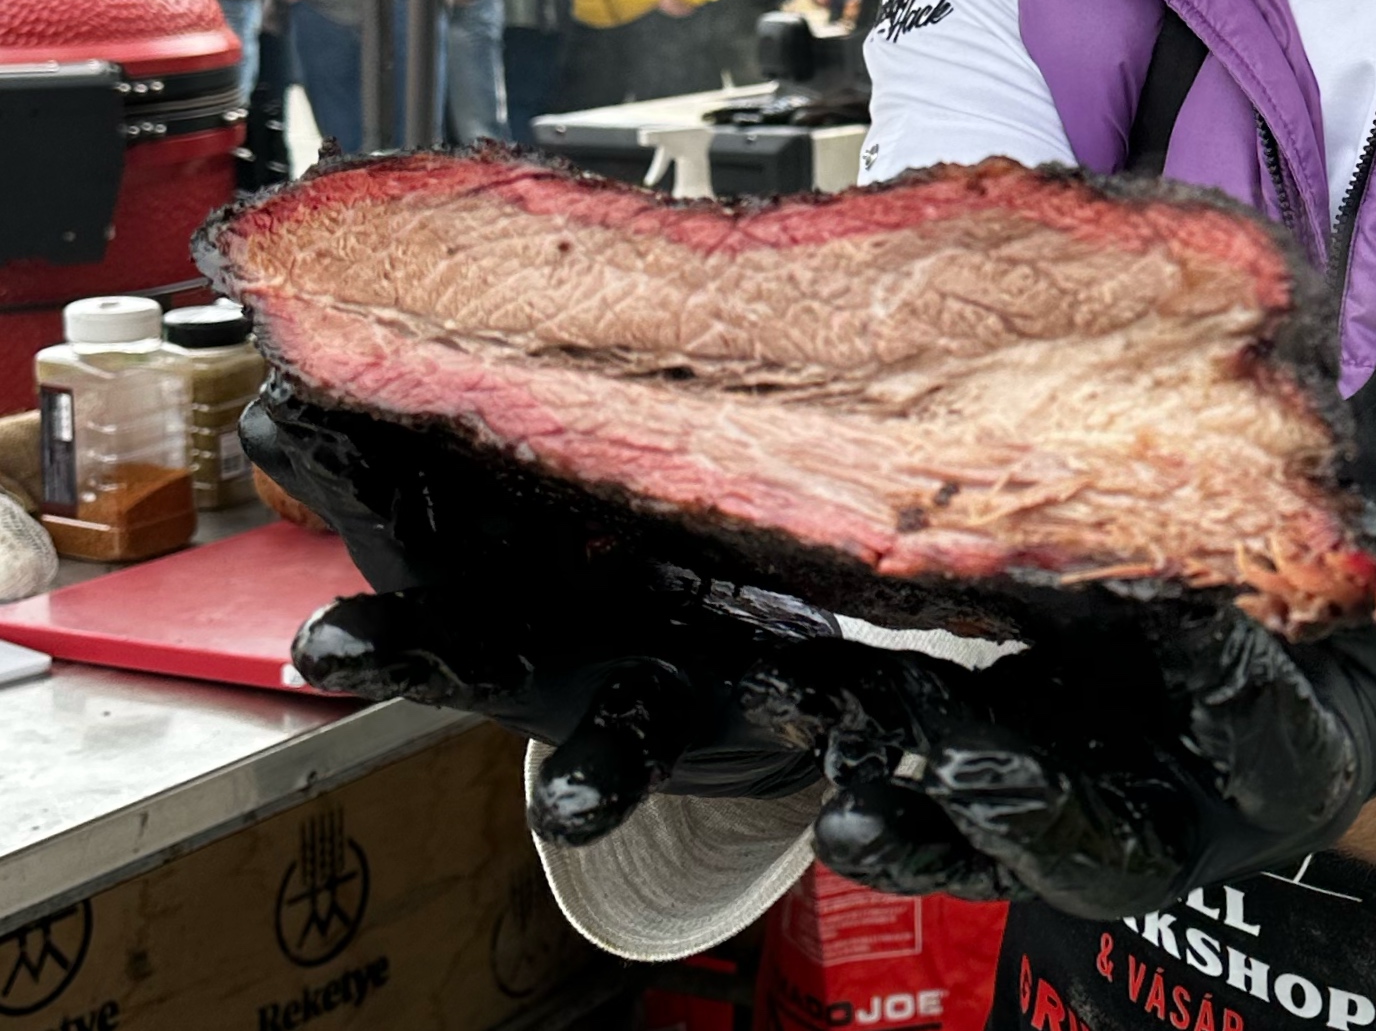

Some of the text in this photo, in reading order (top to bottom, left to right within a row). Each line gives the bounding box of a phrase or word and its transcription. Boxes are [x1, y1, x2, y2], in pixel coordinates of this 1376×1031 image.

[1095, 931, 1114, 983] &
[1122, 909, 1376, 1031] KSHOP
[855, 988, 945, 1024] JOE
